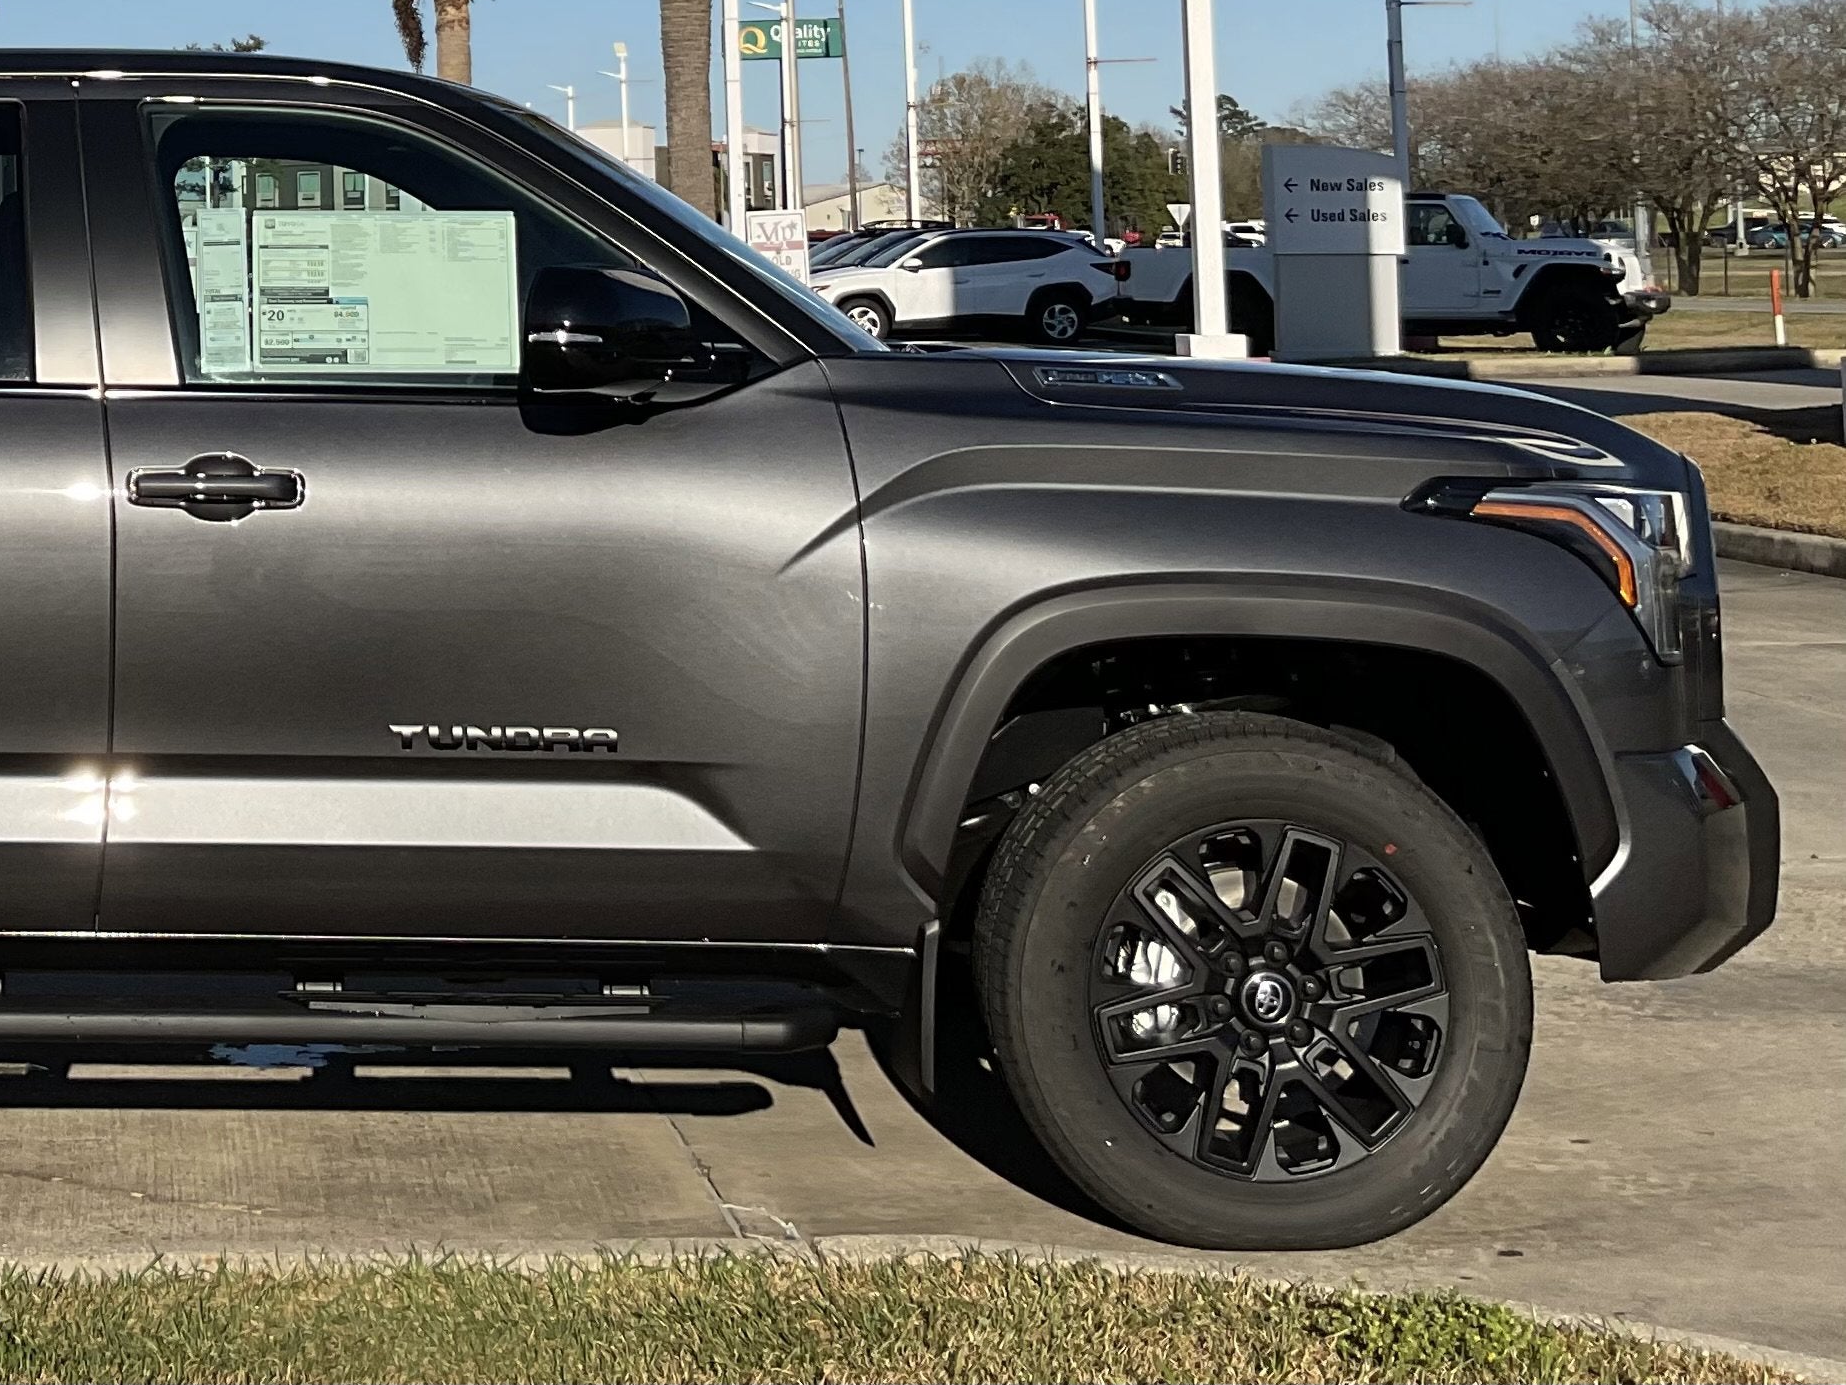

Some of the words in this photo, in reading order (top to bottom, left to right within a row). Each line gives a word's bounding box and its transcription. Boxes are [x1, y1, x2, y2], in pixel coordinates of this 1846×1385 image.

[770, 24, 831, 43] Qality
[1309, 178, 1342, 192] New
[1346, 177, 1385, 192] Sales
[1310, 208, 1345, 223] Used
[1349, 208, 1388, 223] Sales
[1516, 248, 1598, 257] MOJAVE
[267, 309, 285, 322] 20
[388, 724, 619, 753] TUNDRA
